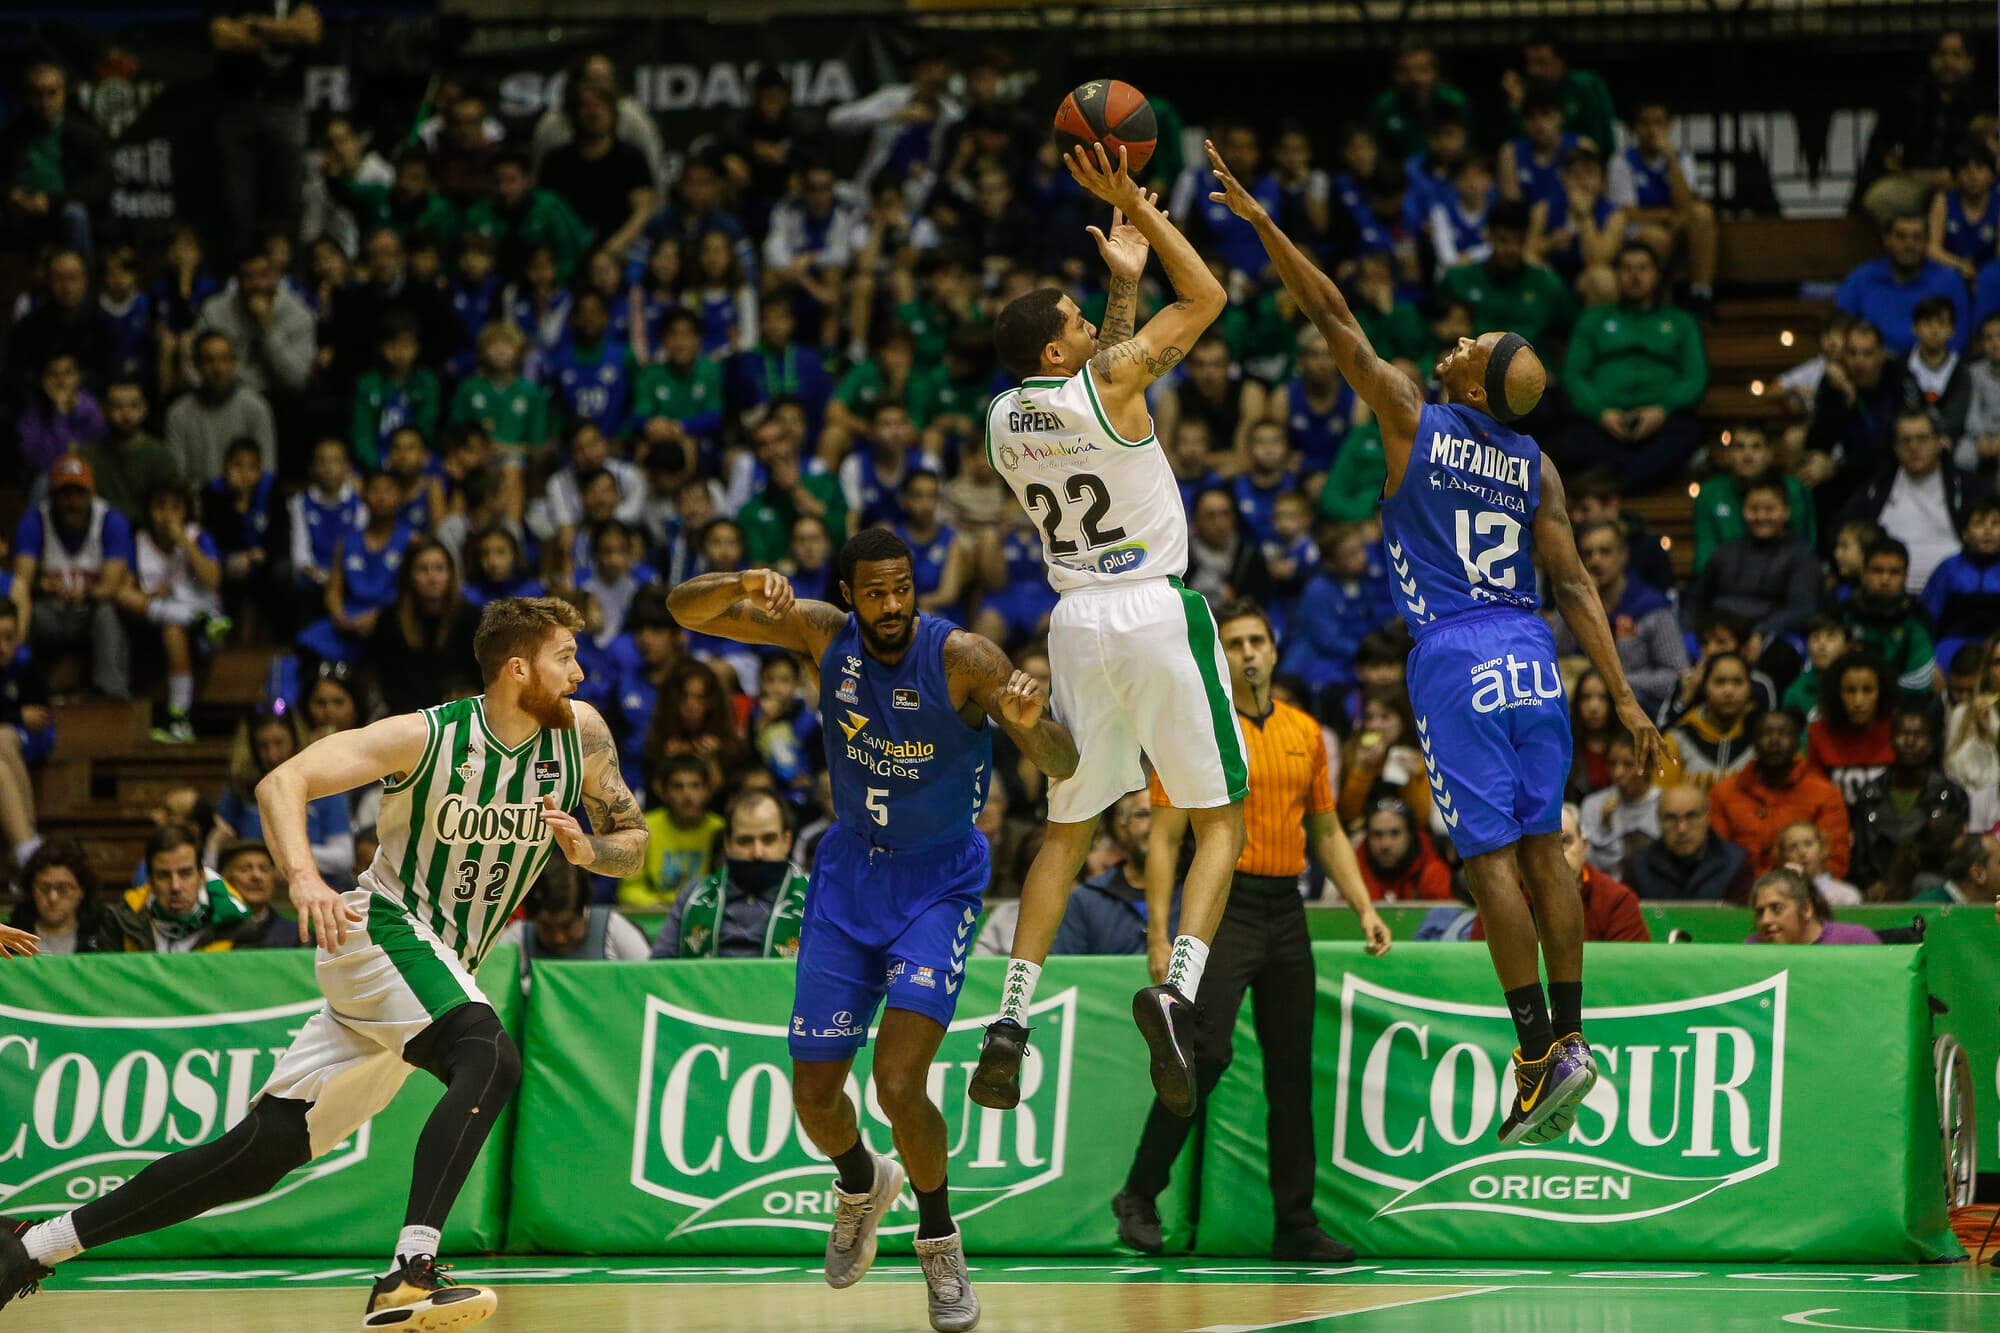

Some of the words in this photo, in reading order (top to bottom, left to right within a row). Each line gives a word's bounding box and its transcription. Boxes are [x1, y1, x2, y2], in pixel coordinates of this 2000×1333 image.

[1009, 411, 1066, 434] GREEN
[1025, 473, 1127, 558] 22
[1103, 551, 1137, 573] plus
[1455, 509, 1522, 590] 12
[1470, 657, 1503, 675] GRUPO
[1471, 654, 1562, 714] atu
[846, 743, 920, 780] BURGOS
[865, 786, 890, 827] 5
[452, 859, 512, 904] 32
[812, 1024, 863, 1038] LEXUS
[762, 1190, 919, 1215] ORIN
[1468, 1174, 1632, 1201] ORIGEN
